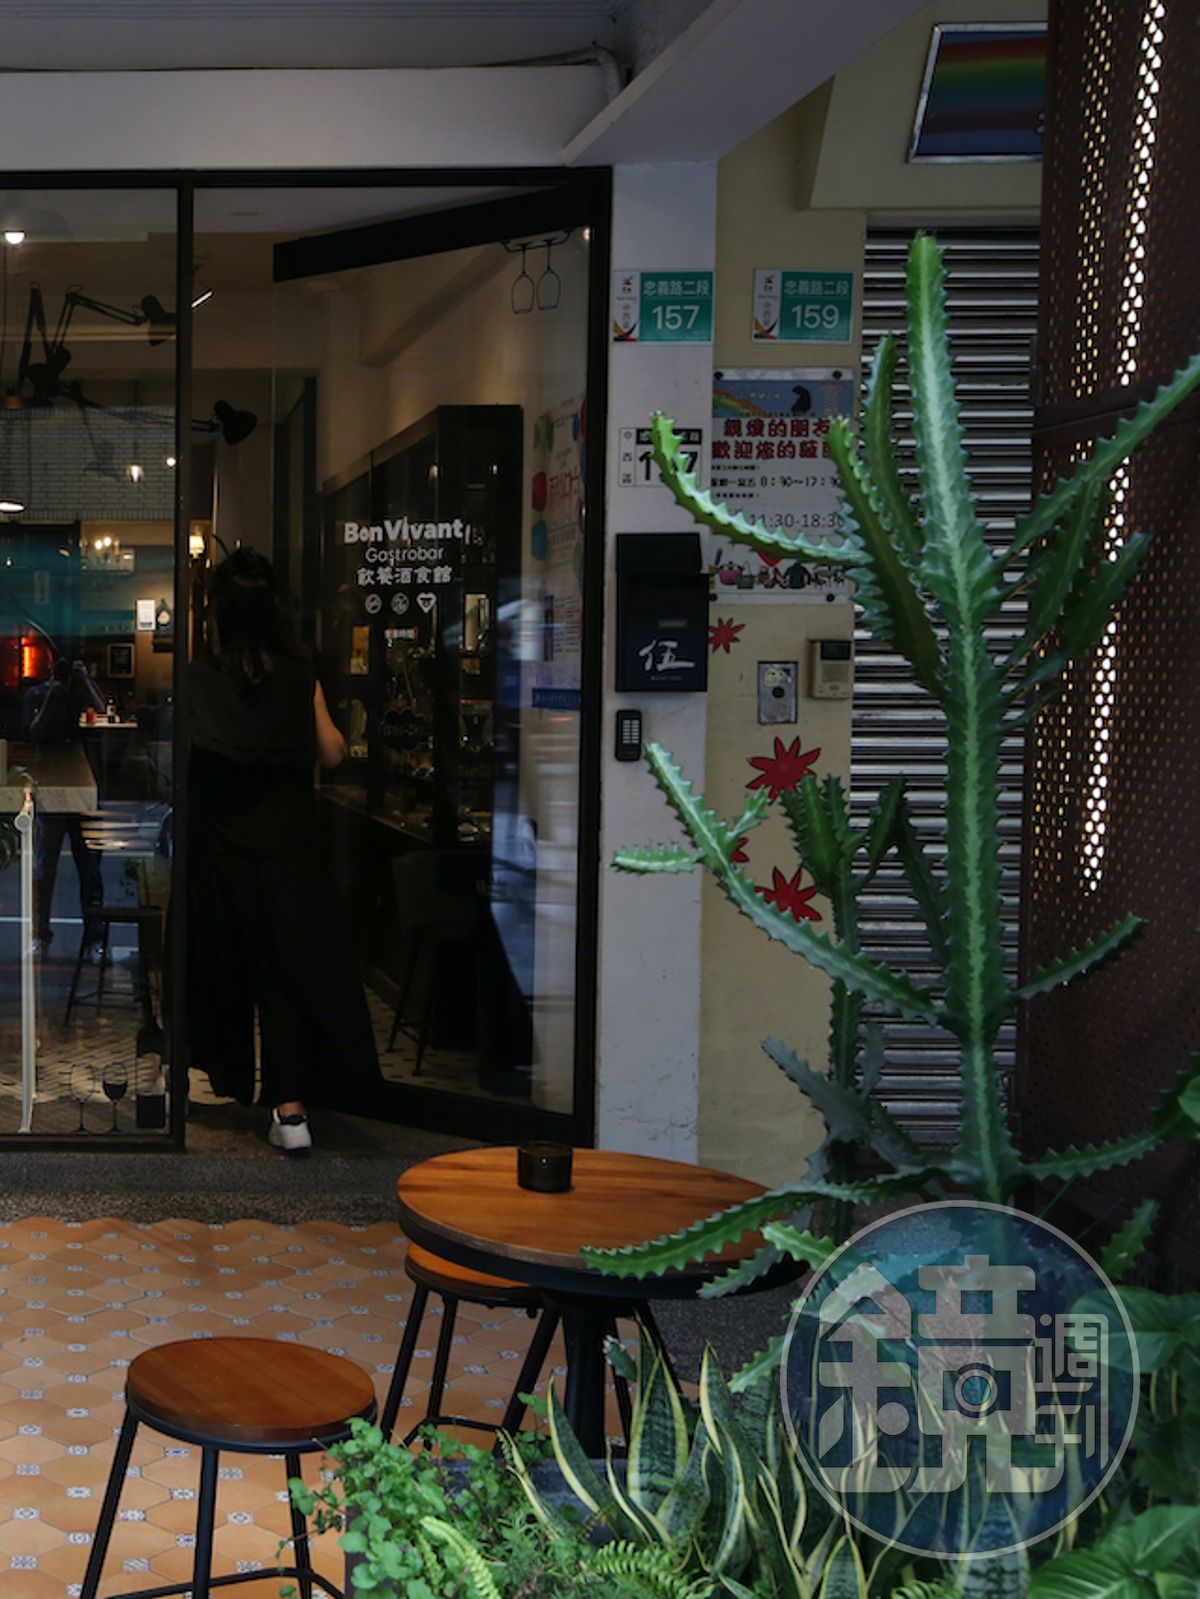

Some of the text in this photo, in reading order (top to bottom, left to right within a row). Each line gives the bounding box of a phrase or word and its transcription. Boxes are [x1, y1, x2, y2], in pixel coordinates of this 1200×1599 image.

[652, 304, 700, 330] 157
[791, 304, 840, 329] 159
[639, 451, 698, 480] 17
[365, 545, 445, 563] Gastrobar
